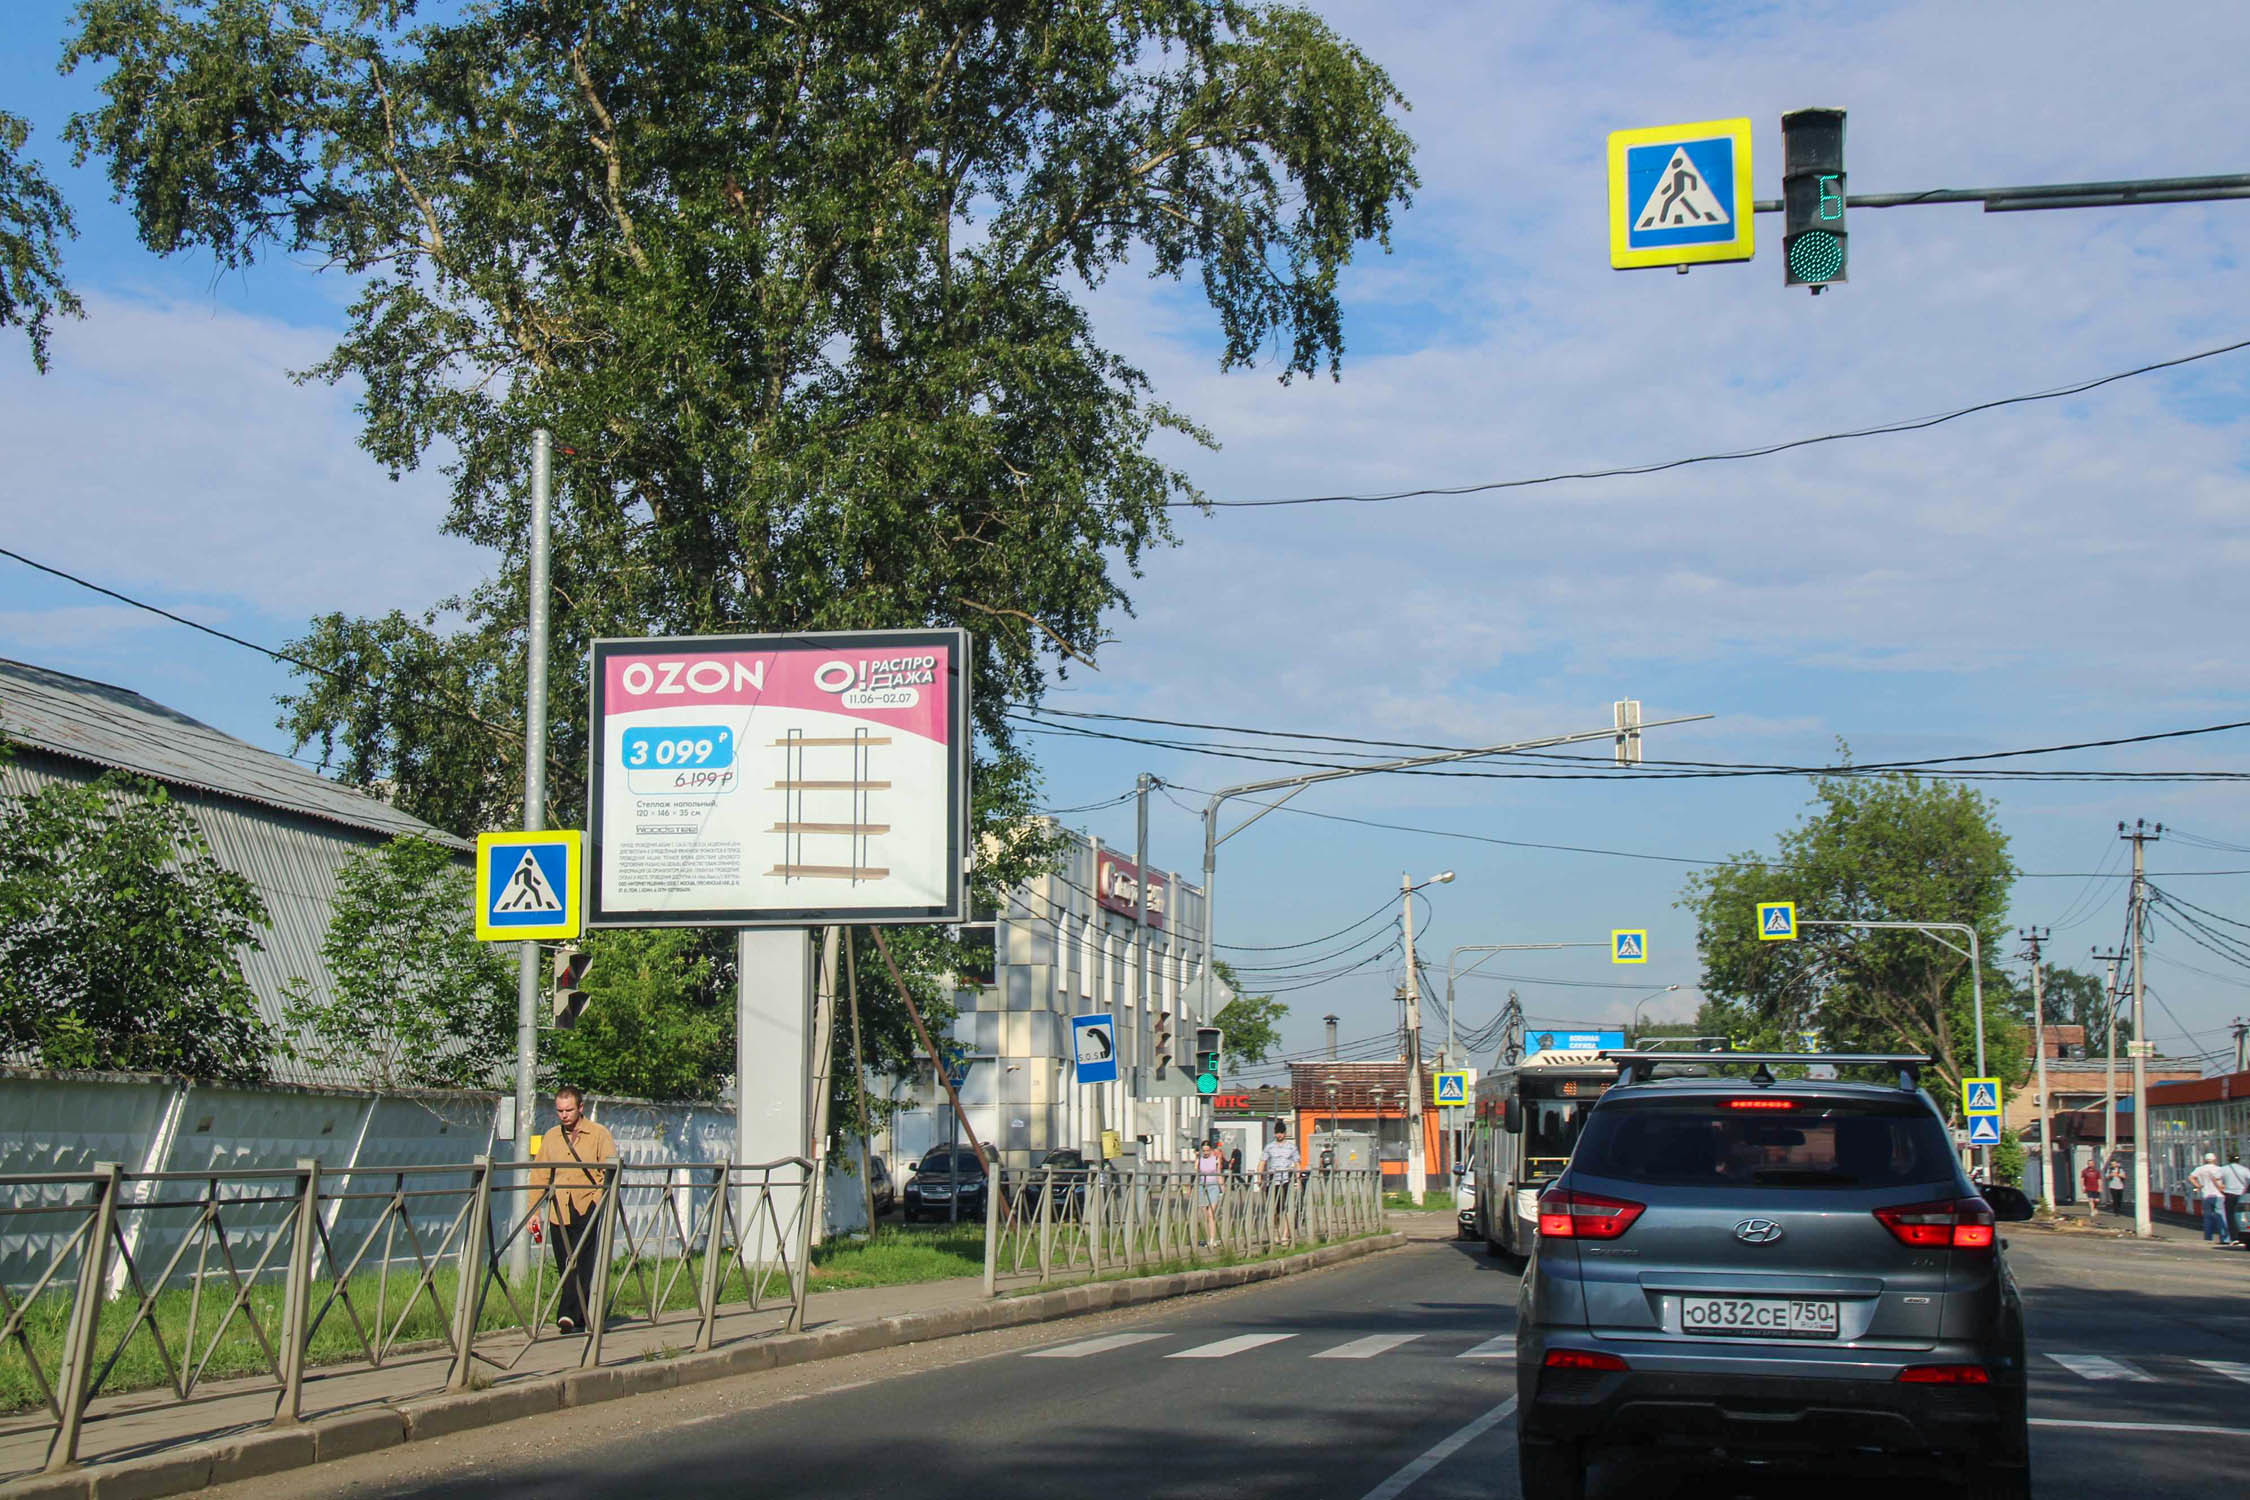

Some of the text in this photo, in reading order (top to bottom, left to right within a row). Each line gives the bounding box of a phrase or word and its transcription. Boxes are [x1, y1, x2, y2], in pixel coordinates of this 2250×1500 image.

[1819, 174, 1842, 220] 6
[871, 655, 935, 673] РАСПРО
[623, 660, 764, 695] OZON
[869, 670, 934, 690] ДАЖА
[658, 809, 670, 817] 146
[679, 809, 689, 817] 35
[1208, 1052, 1219, 1071] 6
[1792, 1302, 1829, 1322] 750
